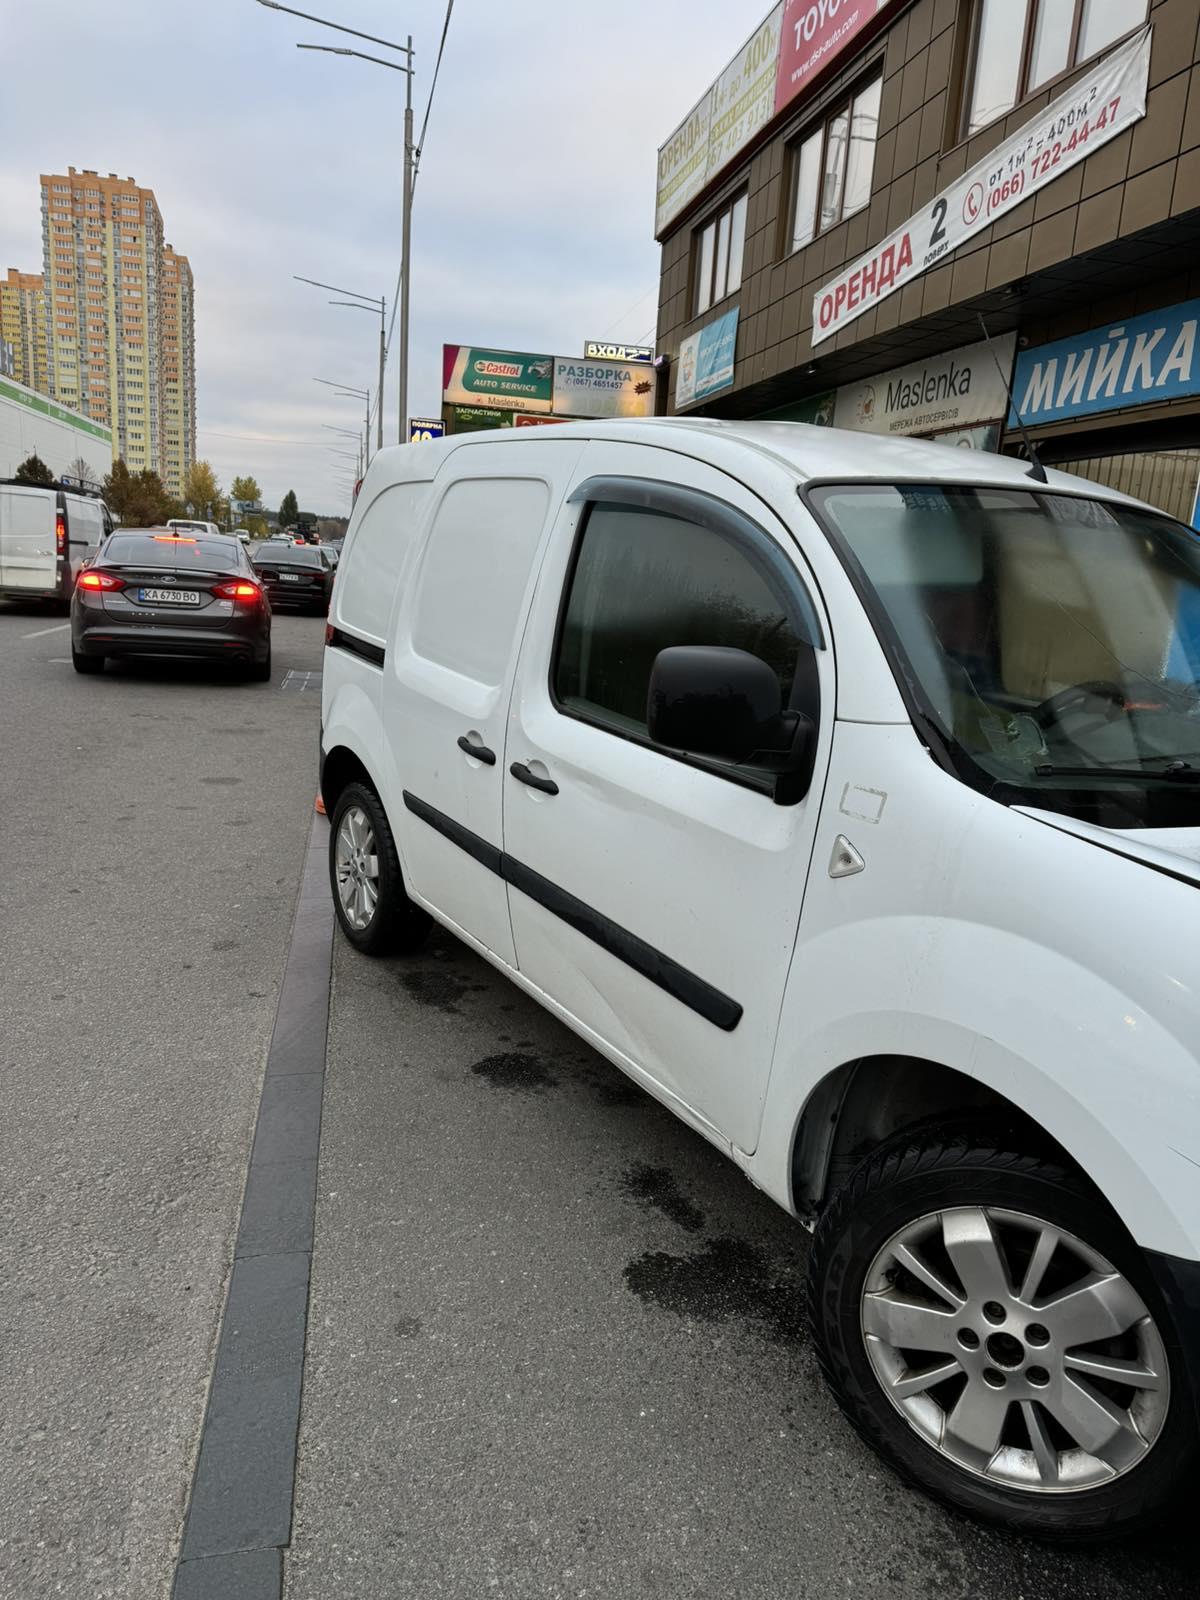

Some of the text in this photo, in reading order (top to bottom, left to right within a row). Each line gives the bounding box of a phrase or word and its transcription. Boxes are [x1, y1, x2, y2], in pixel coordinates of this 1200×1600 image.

[794, 0, 848, 51] TOYO
[987, 96, 1121, 217] (066) 722-44-47
[929, 198, 948, 248] 2
[819, 232, 913, 329] ОРЕНДА
[588, 344, 626, 358] ВХОД
[486, 362, 520, 376] Castrol
[558, 364, 632, 382] РАЗБОРКА
[1019, 319, 1198, 416] МИЙКА
[473, 378, 537, 393] AUTO SERVICE
[884, 361, 972, 414] Maslenka
[455, 406, 502, 417] ЗАПЧАСТИНИ
[487, 396, 526, 409] Maslenka
[144, 589, 197, 602] KA 6730 BO
